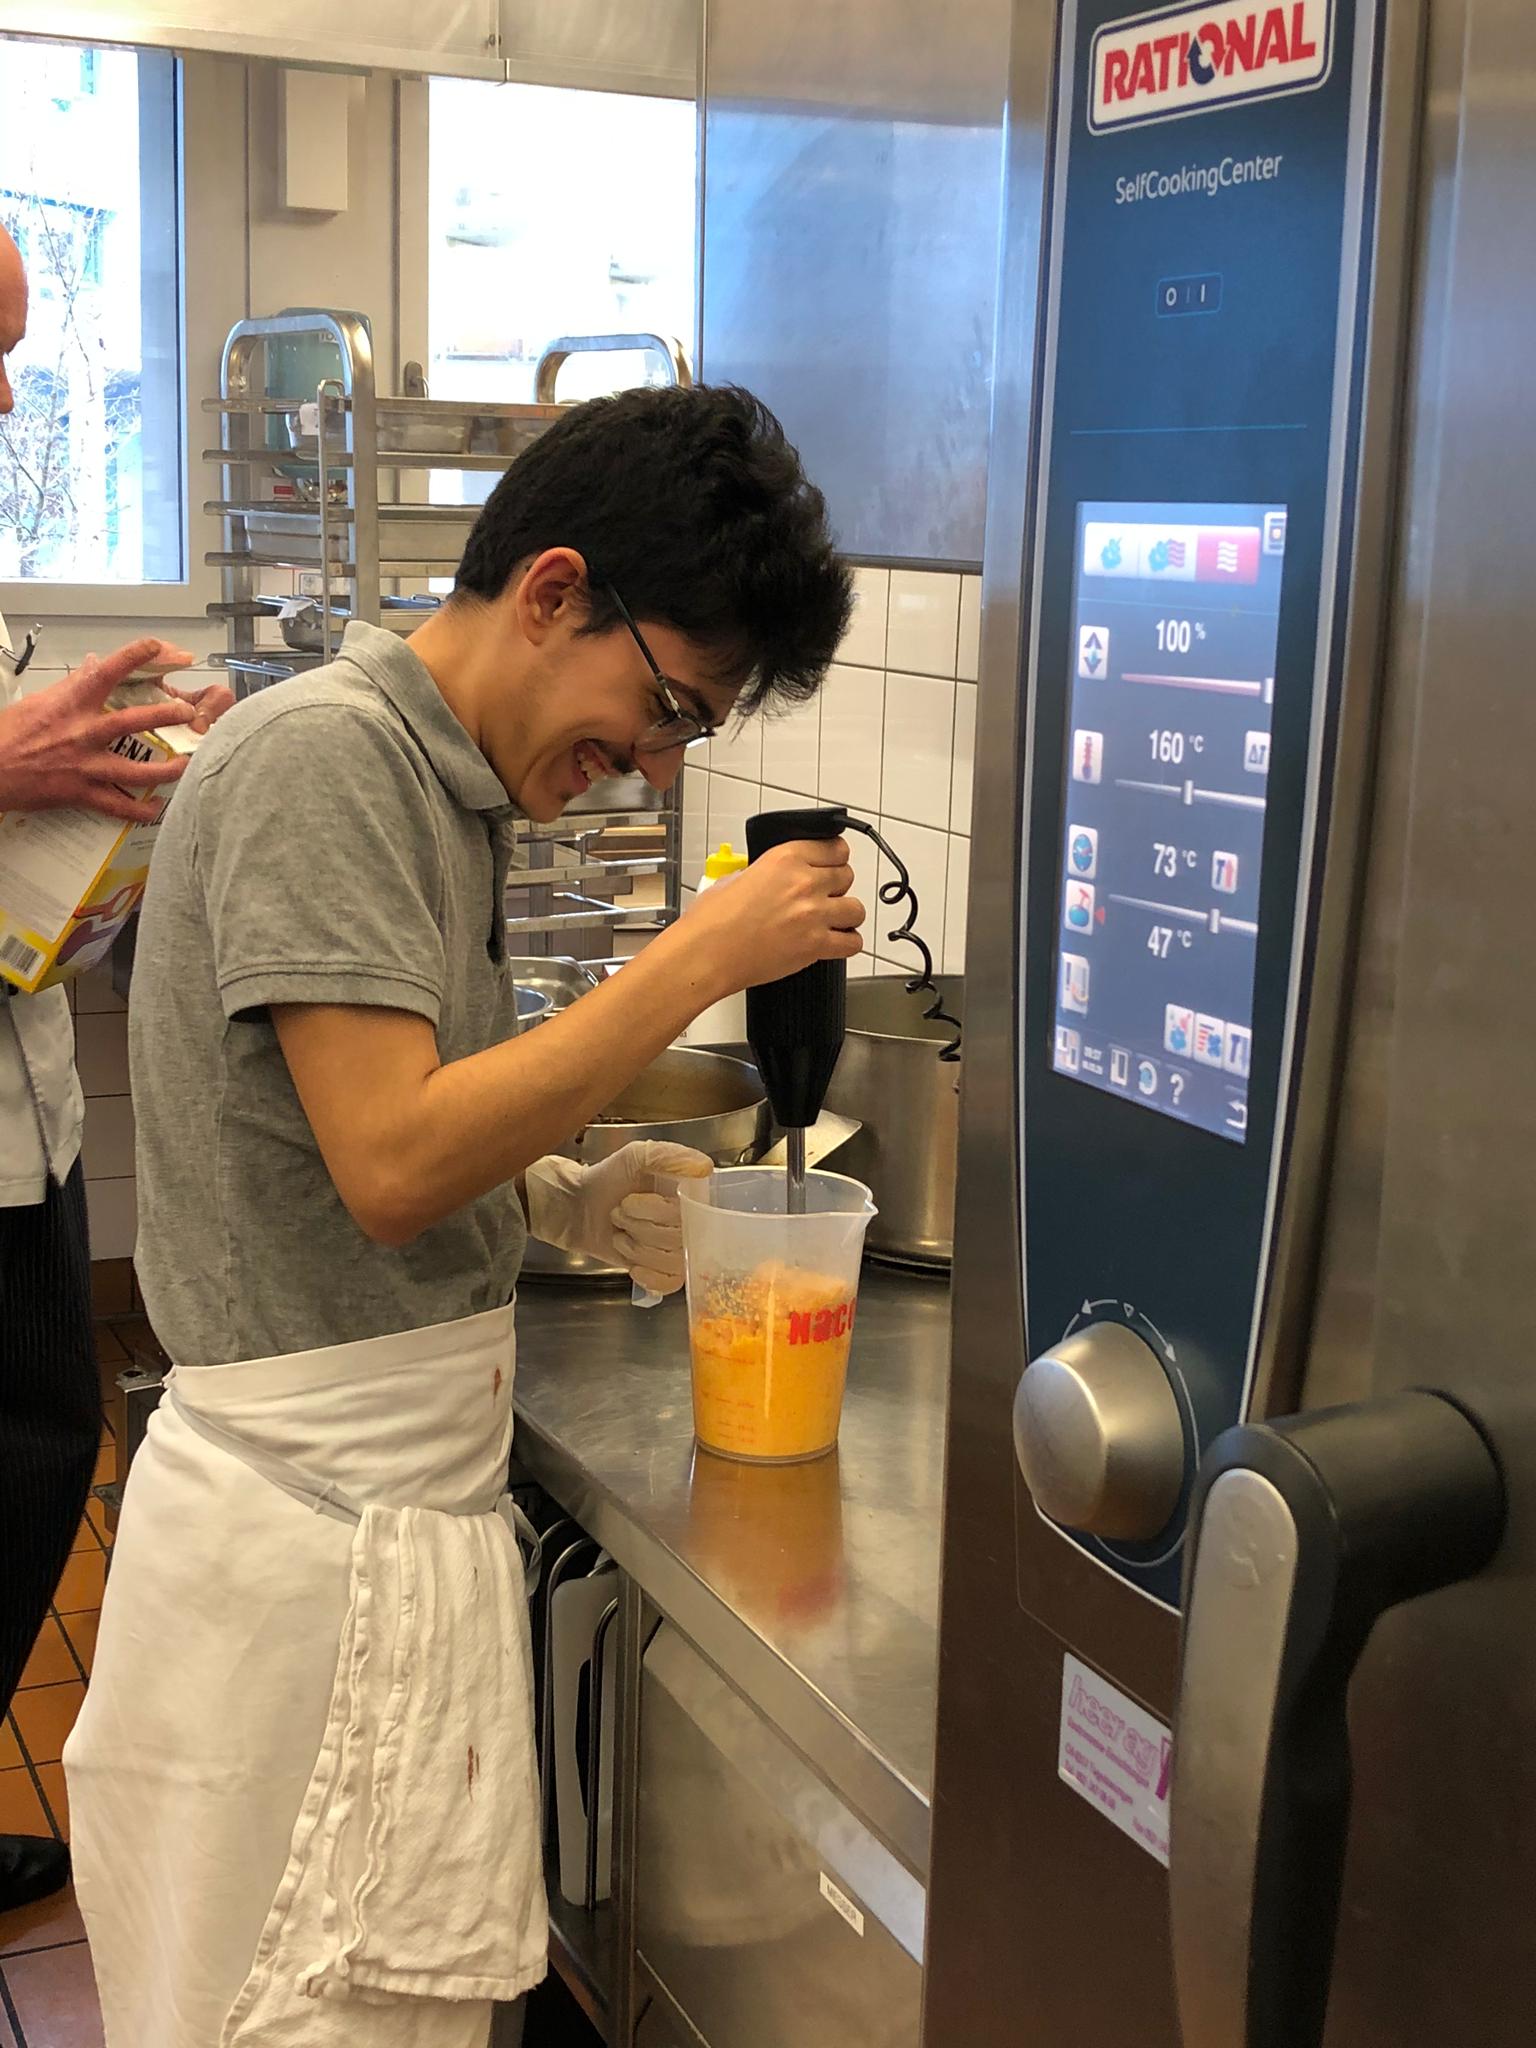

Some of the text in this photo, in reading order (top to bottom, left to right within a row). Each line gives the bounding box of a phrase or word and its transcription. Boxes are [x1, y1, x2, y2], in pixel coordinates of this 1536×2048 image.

[1102, 3, 1316, 105] RATIONAL
[1115, 155, 1282, 204] SelfCookingCenter
[1156, 619, 1191, 653] 100
[108, 733, 154, 763] ENA
[1149, 729, 1184, 764] 160
[1153, 842, 1177, 878] 73
[1147, 925, 1173, 959] 47
